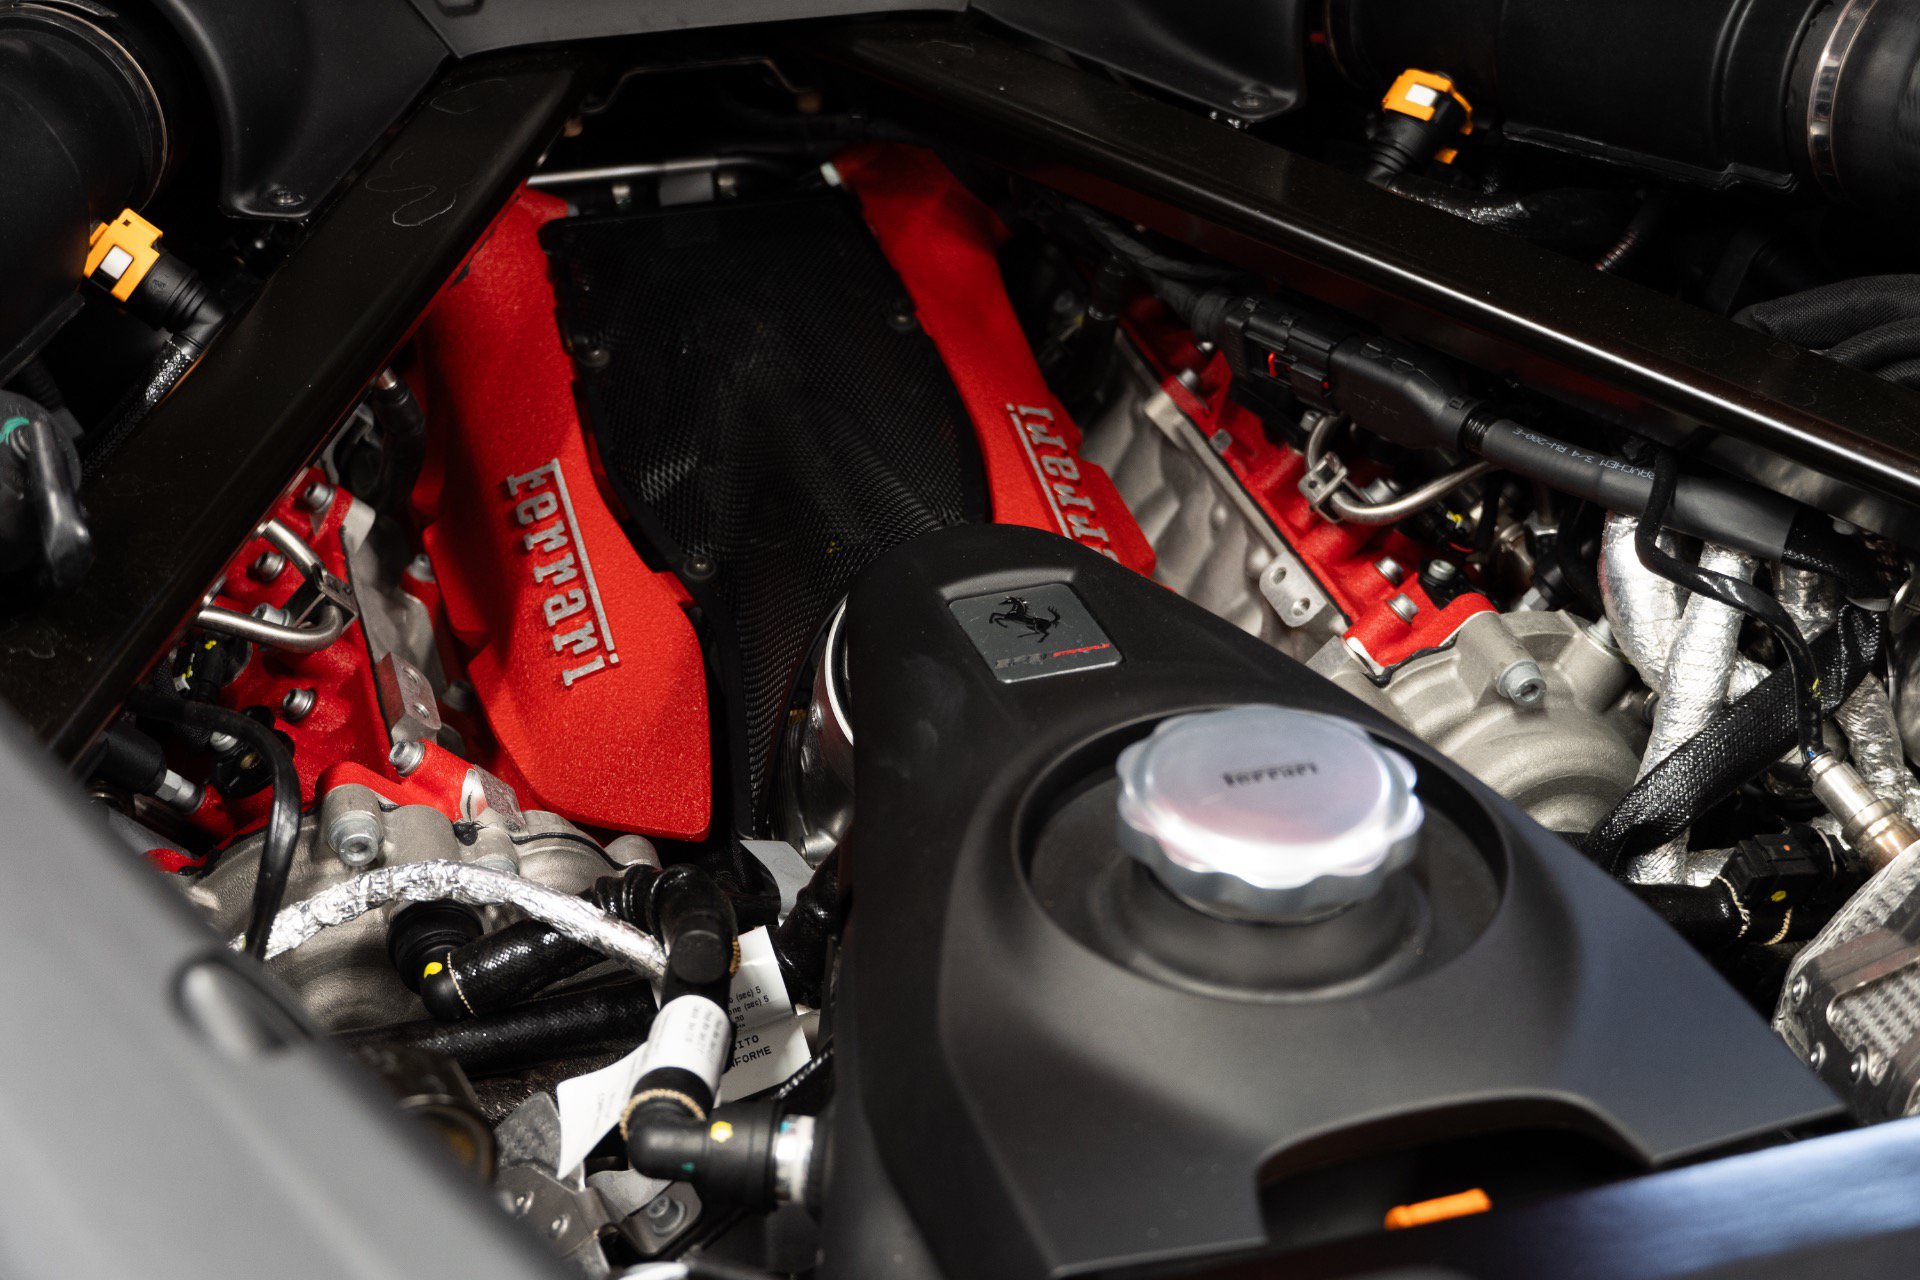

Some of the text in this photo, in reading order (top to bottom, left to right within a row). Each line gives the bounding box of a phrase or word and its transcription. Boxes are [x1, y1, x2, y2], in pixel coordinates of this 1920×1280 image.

[1571, 449, 1596, 463] 3/4
[1006, 402, 1120, 564] rrari
[506, 457, 619, 688] Ferrari
[736, 989, 754, 1001] (sec)
[755, 985, 762, 994] 5
[744, 999, 762, 1011] (sec)
[763, 994, 770, 1003] 5
[735, 1035, 759, 1050] ITO
